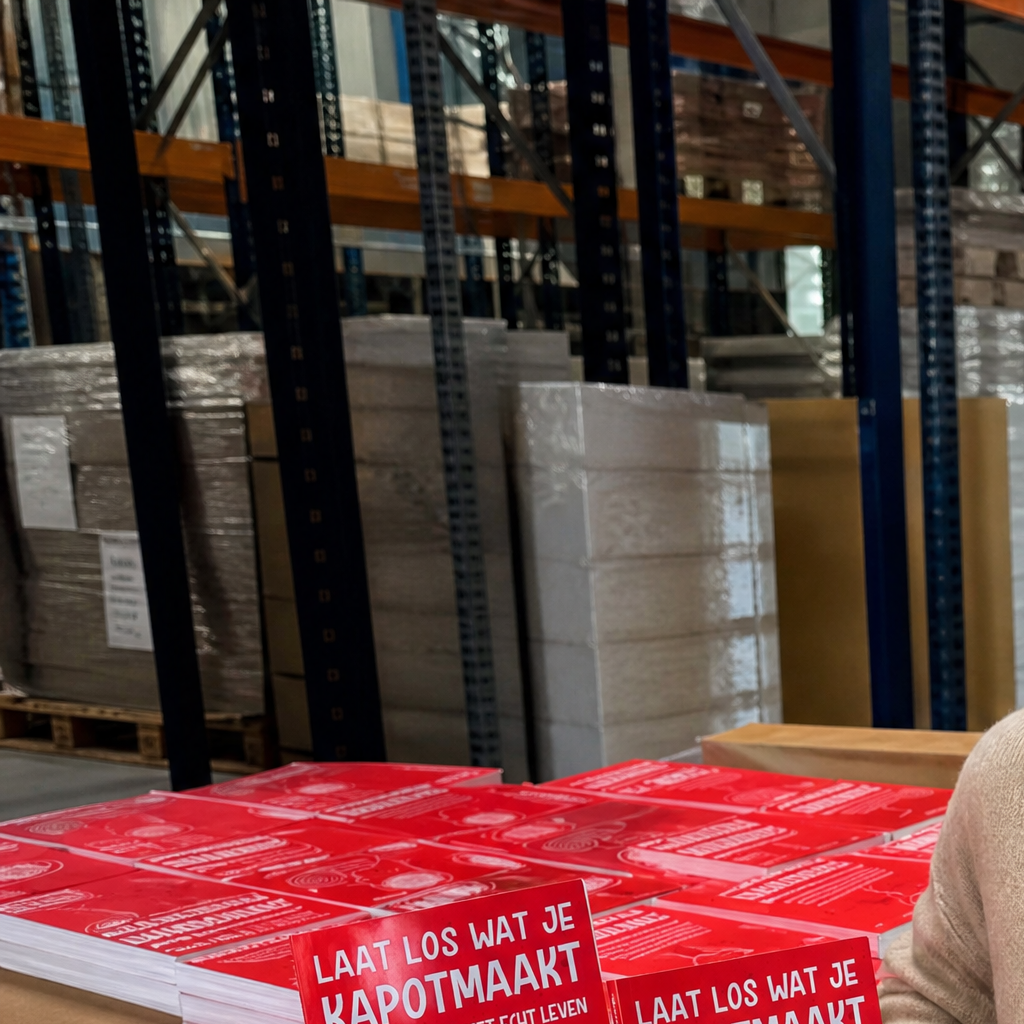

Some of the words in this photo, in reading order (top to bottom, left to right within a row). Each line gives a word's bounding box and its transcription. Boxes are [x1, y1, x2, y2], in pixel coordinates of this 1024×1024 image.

[313, 940, 391, 984] LAAT
[402, 927, 458, 965] LOS
[468, 911, 528, 950] WAT
[542, 901, 575, 934] JE
[540, 997, 588, 1024] LEVEN
[711, 979, 758, 1013] LOS
[766, 966, 817, 1002] WAT
[829, 958, 858, 988] JE
